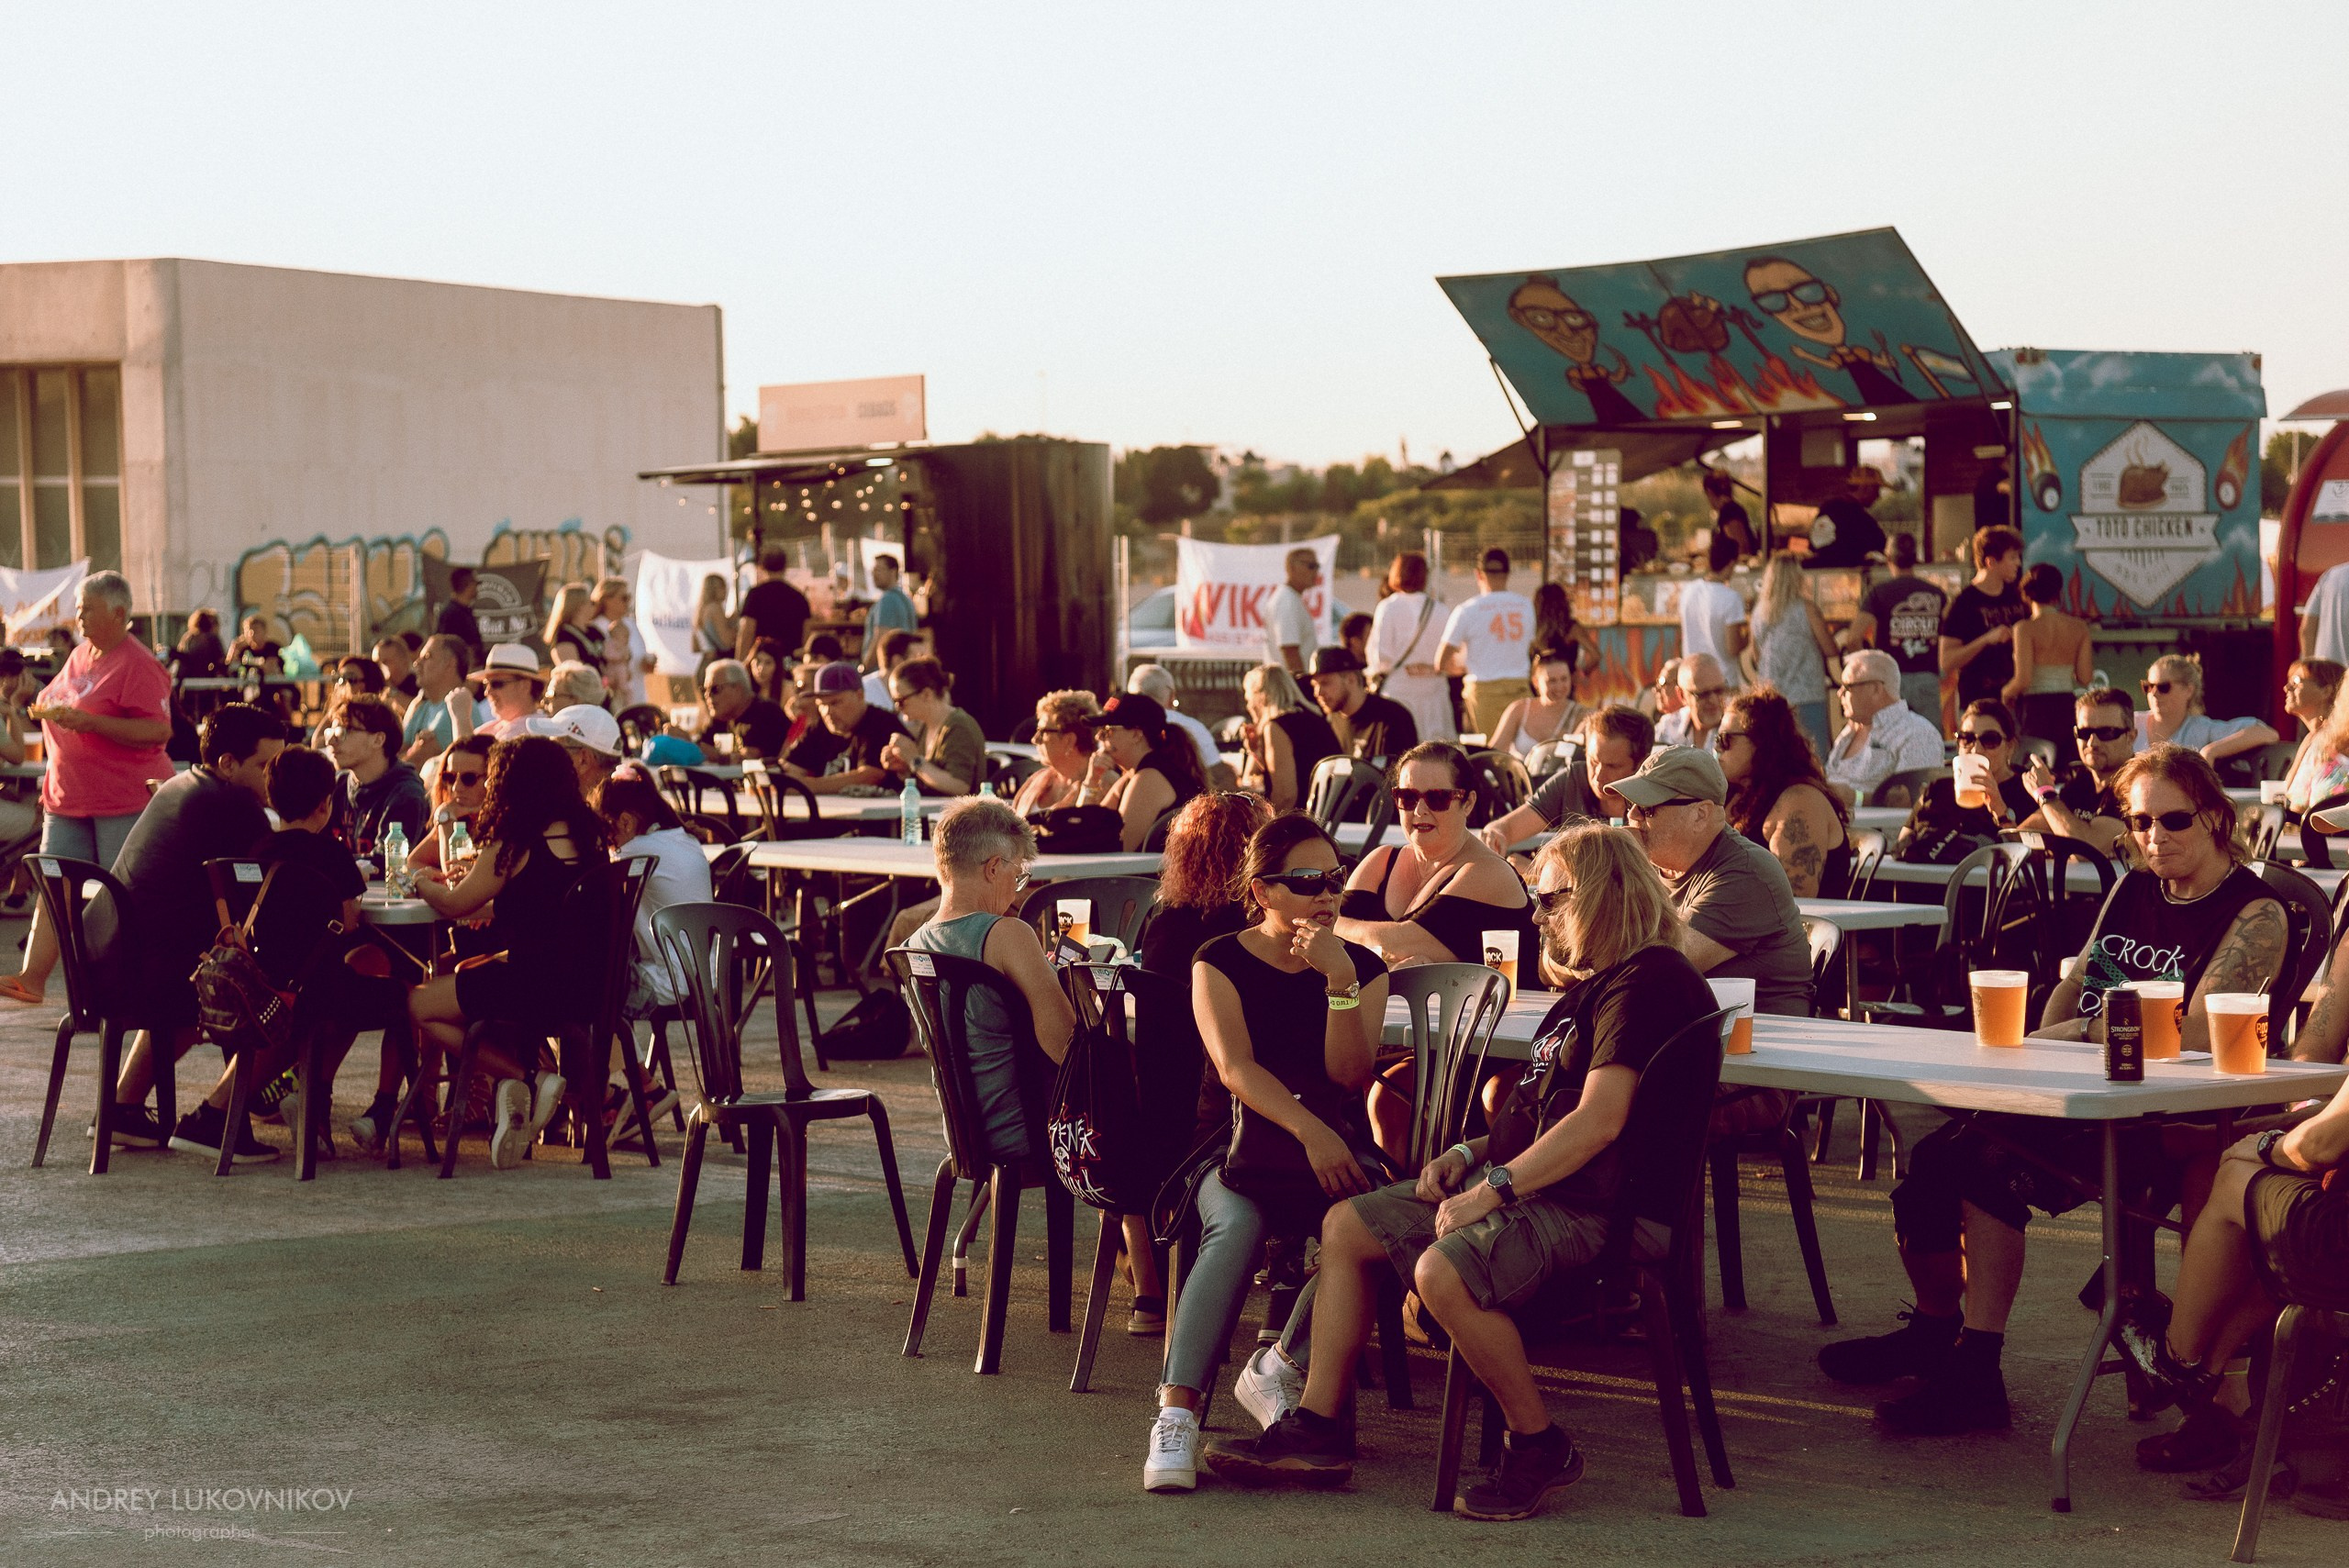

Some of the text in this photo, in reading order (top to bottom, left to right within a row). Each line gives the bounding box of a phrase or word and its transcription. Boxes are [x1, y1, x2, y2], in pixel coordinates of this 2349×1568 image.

[2097, 516, 2194, 539] TOTO CHICKEN
[1488, 611, 1525, 642] 45
[2100, 934, 2186, 978] CROCK
